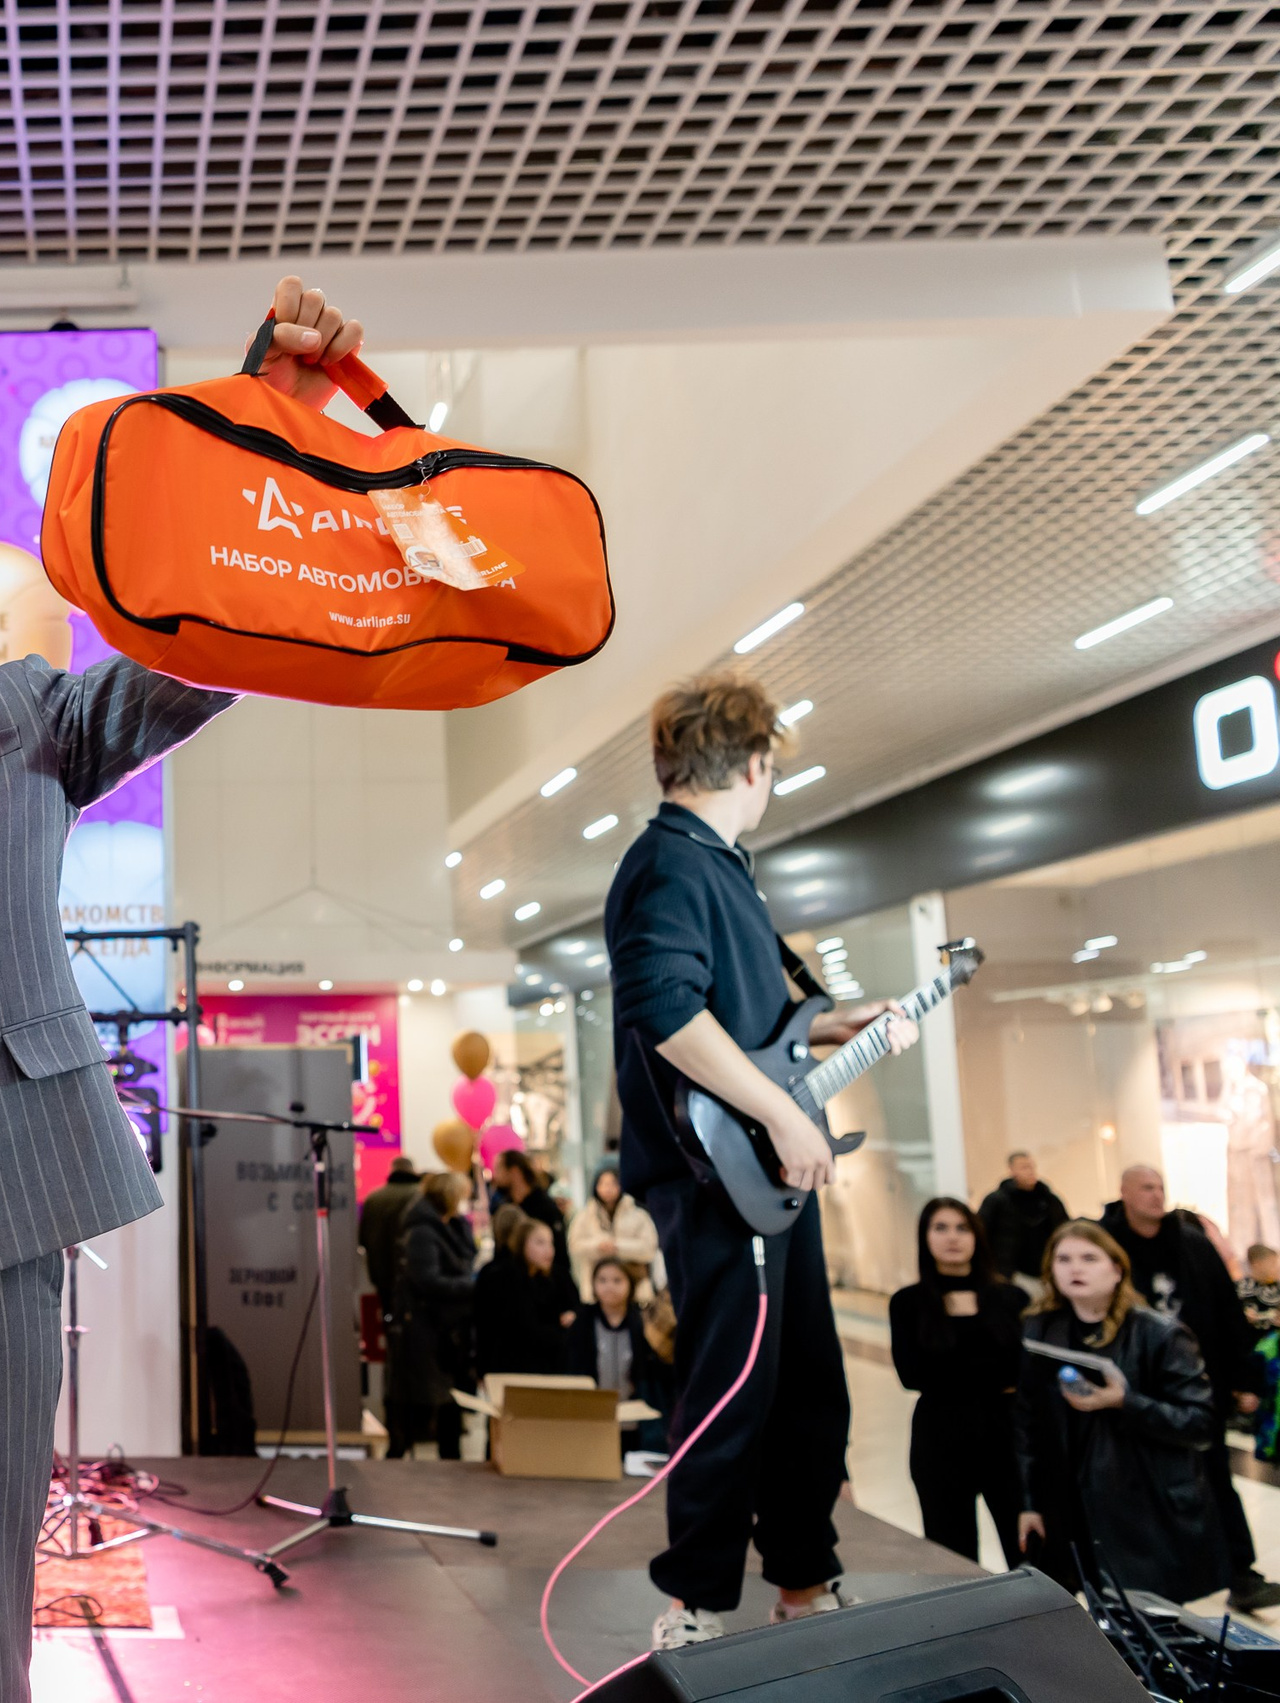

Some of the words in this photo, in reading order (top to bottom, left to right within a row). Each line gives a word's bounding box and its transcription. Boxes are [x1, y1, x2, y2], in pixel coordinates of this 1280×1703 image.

[210, 546, 293, 578] НАБОР
[297, 562, 517, 594] АВТОМОБА
[328, 610, 411, 629] www.airline.su
[196, 960, 305, 974] НФОРМАЦИЯ
